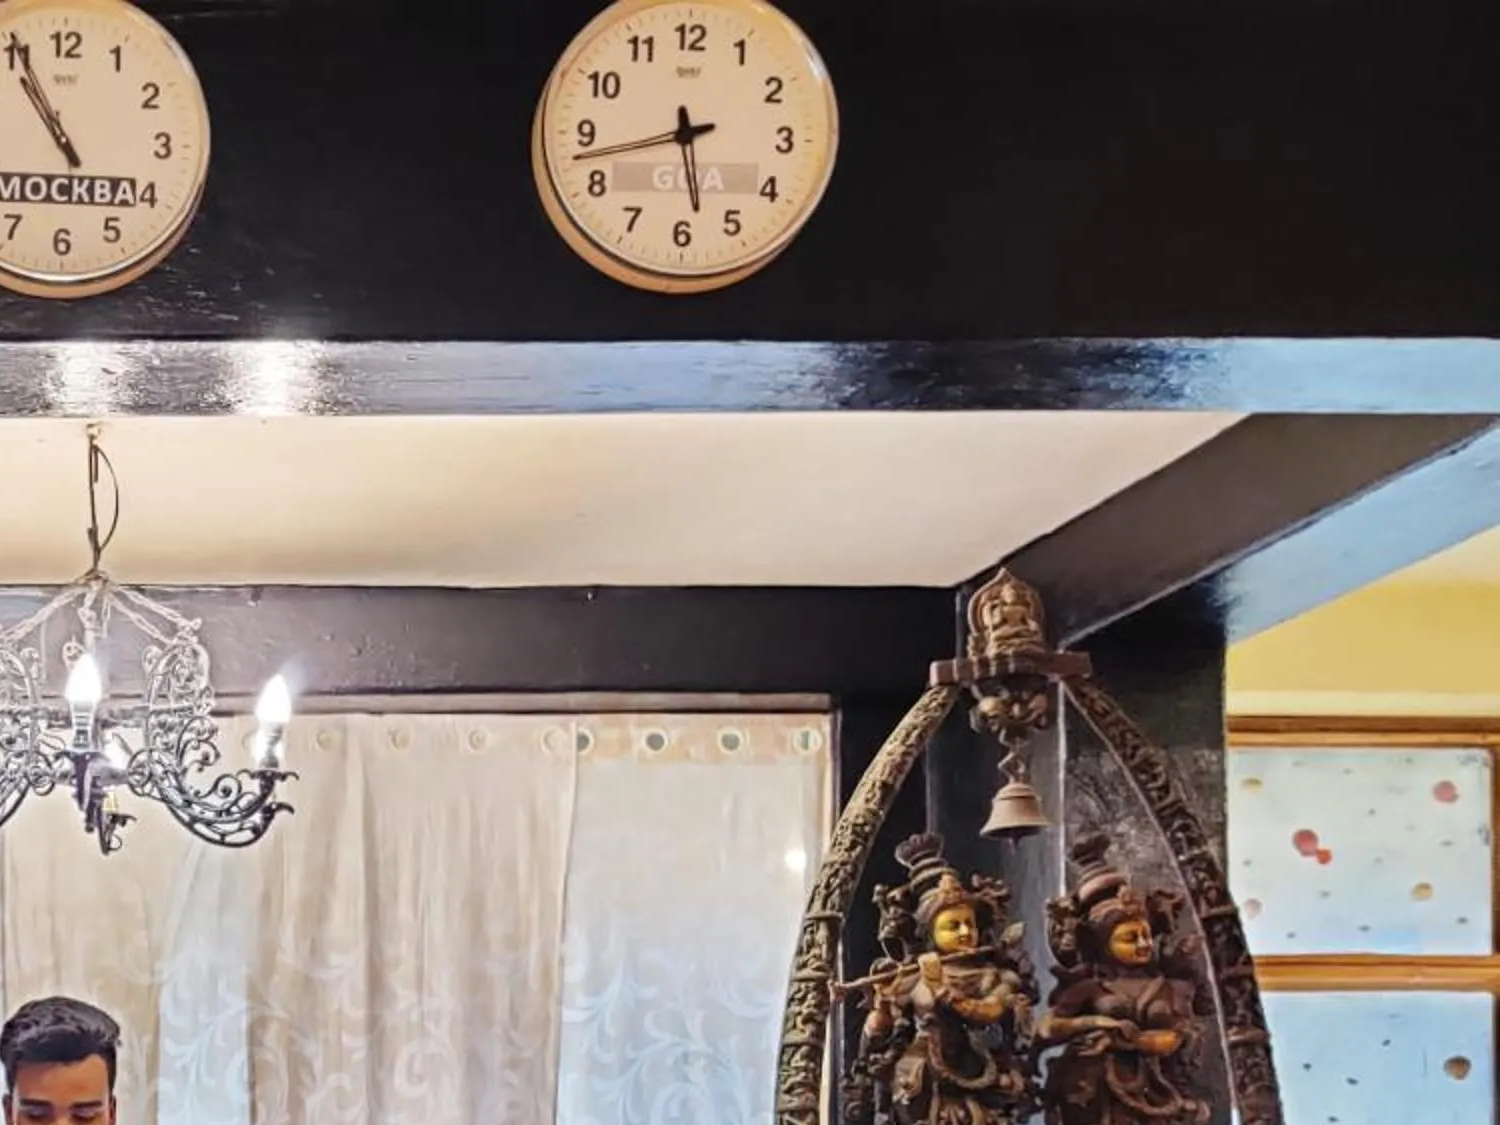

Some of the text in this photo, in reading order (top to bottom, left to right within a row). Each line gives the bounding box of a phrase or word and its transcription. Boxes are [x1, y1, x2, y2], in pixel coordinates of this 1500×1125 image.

[50, 32, 82, 58] 12
[628, 36, 654, 62] 11
[675, 24, 706, 51] 12
[4, 45, 30, 71] 11
[110, 46, 121, 72] 1
[734, 40, 746, 65] 1
[142, 83, 160, 109] 2
[588, 72, 620, 99] 10
[764, 77, 783, 103] 2
[154, 132, 171, 159] 3
[577, 120, 596, 146] 9
[776, 127, 794, 154] 3
[140, 182, 157, 208] 4
[588, 170, 605, 197] 8
[760, 176, 778, 203] 4
[4, 214, 22, 240] 7
[104, 217, 121, 242] 5
[623, 207, 642, 233] 7
[724, 210, 741, 236] 5
[53, 229, 71, 255] 6
[673, 221, 691, 246] 6
